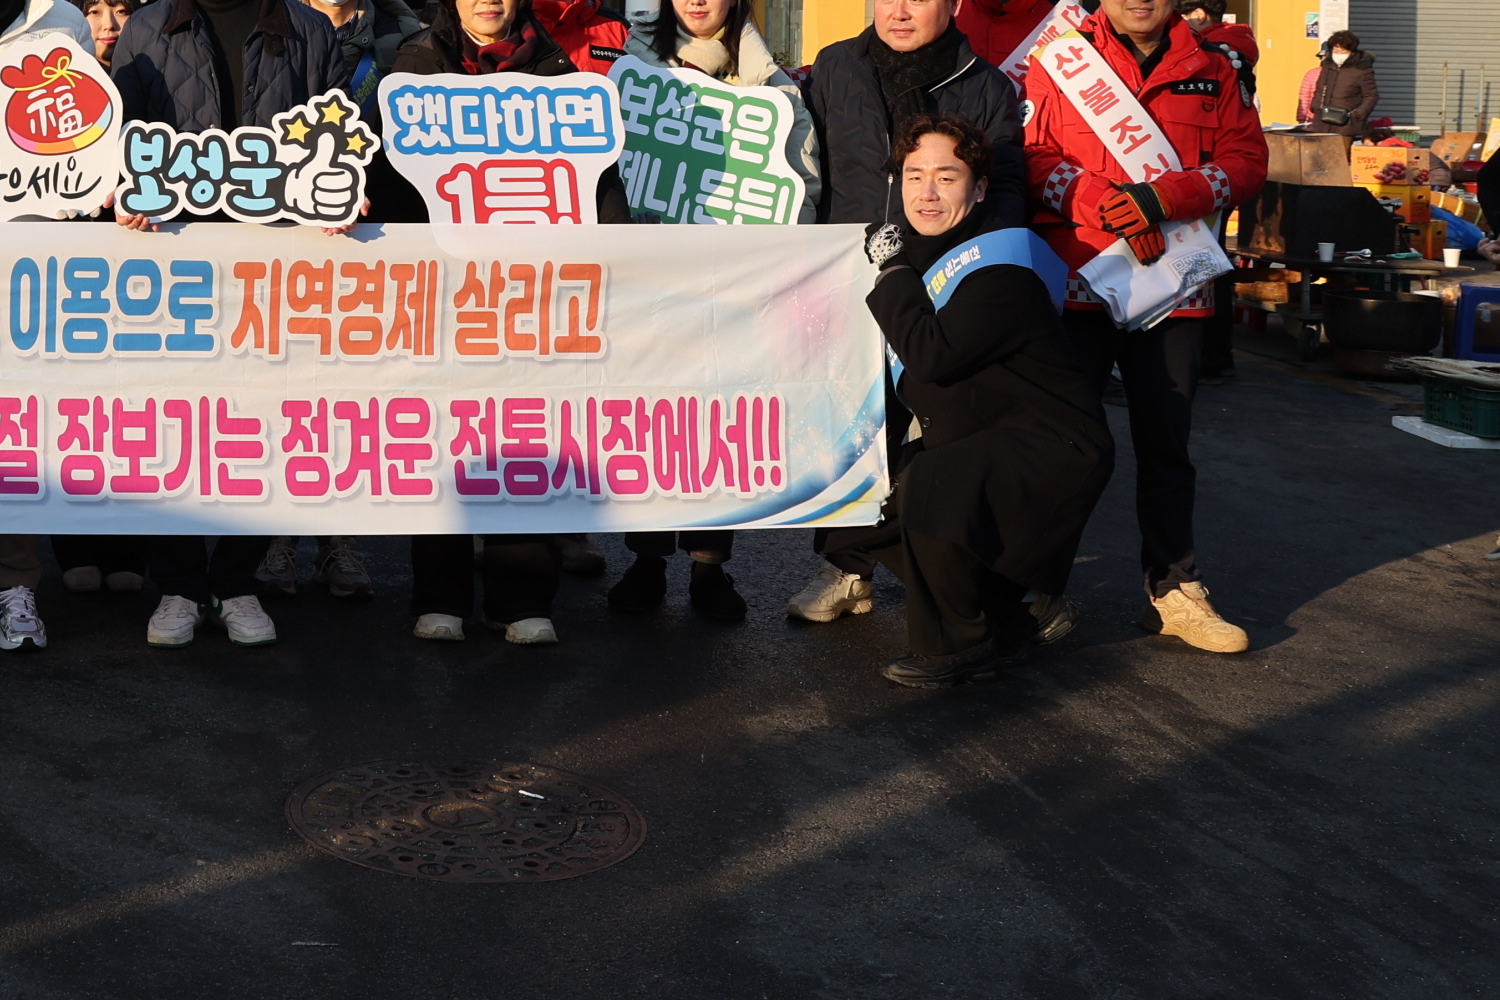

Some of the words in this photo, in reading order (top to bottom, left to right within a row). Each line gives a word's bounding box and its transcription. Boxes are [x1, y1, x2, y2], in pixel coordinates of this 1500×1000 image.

[25, 85, 93, 139] 福
[395, 92, 608, 149] 했다하면
[620, 76, 773, 165] 보성군은
[128, 132, 282, 211] 보성군
[10, 255, 216, 353] 이용으로
[230, 258, 438, 357] 지역경제
[453, 260, 603, 357] 살리고
[57, 395, 263, 497] 장보기는
[281, 396, 434, 497] 정겨운
[449, 395, 782, 496] 전통시장에서!!
